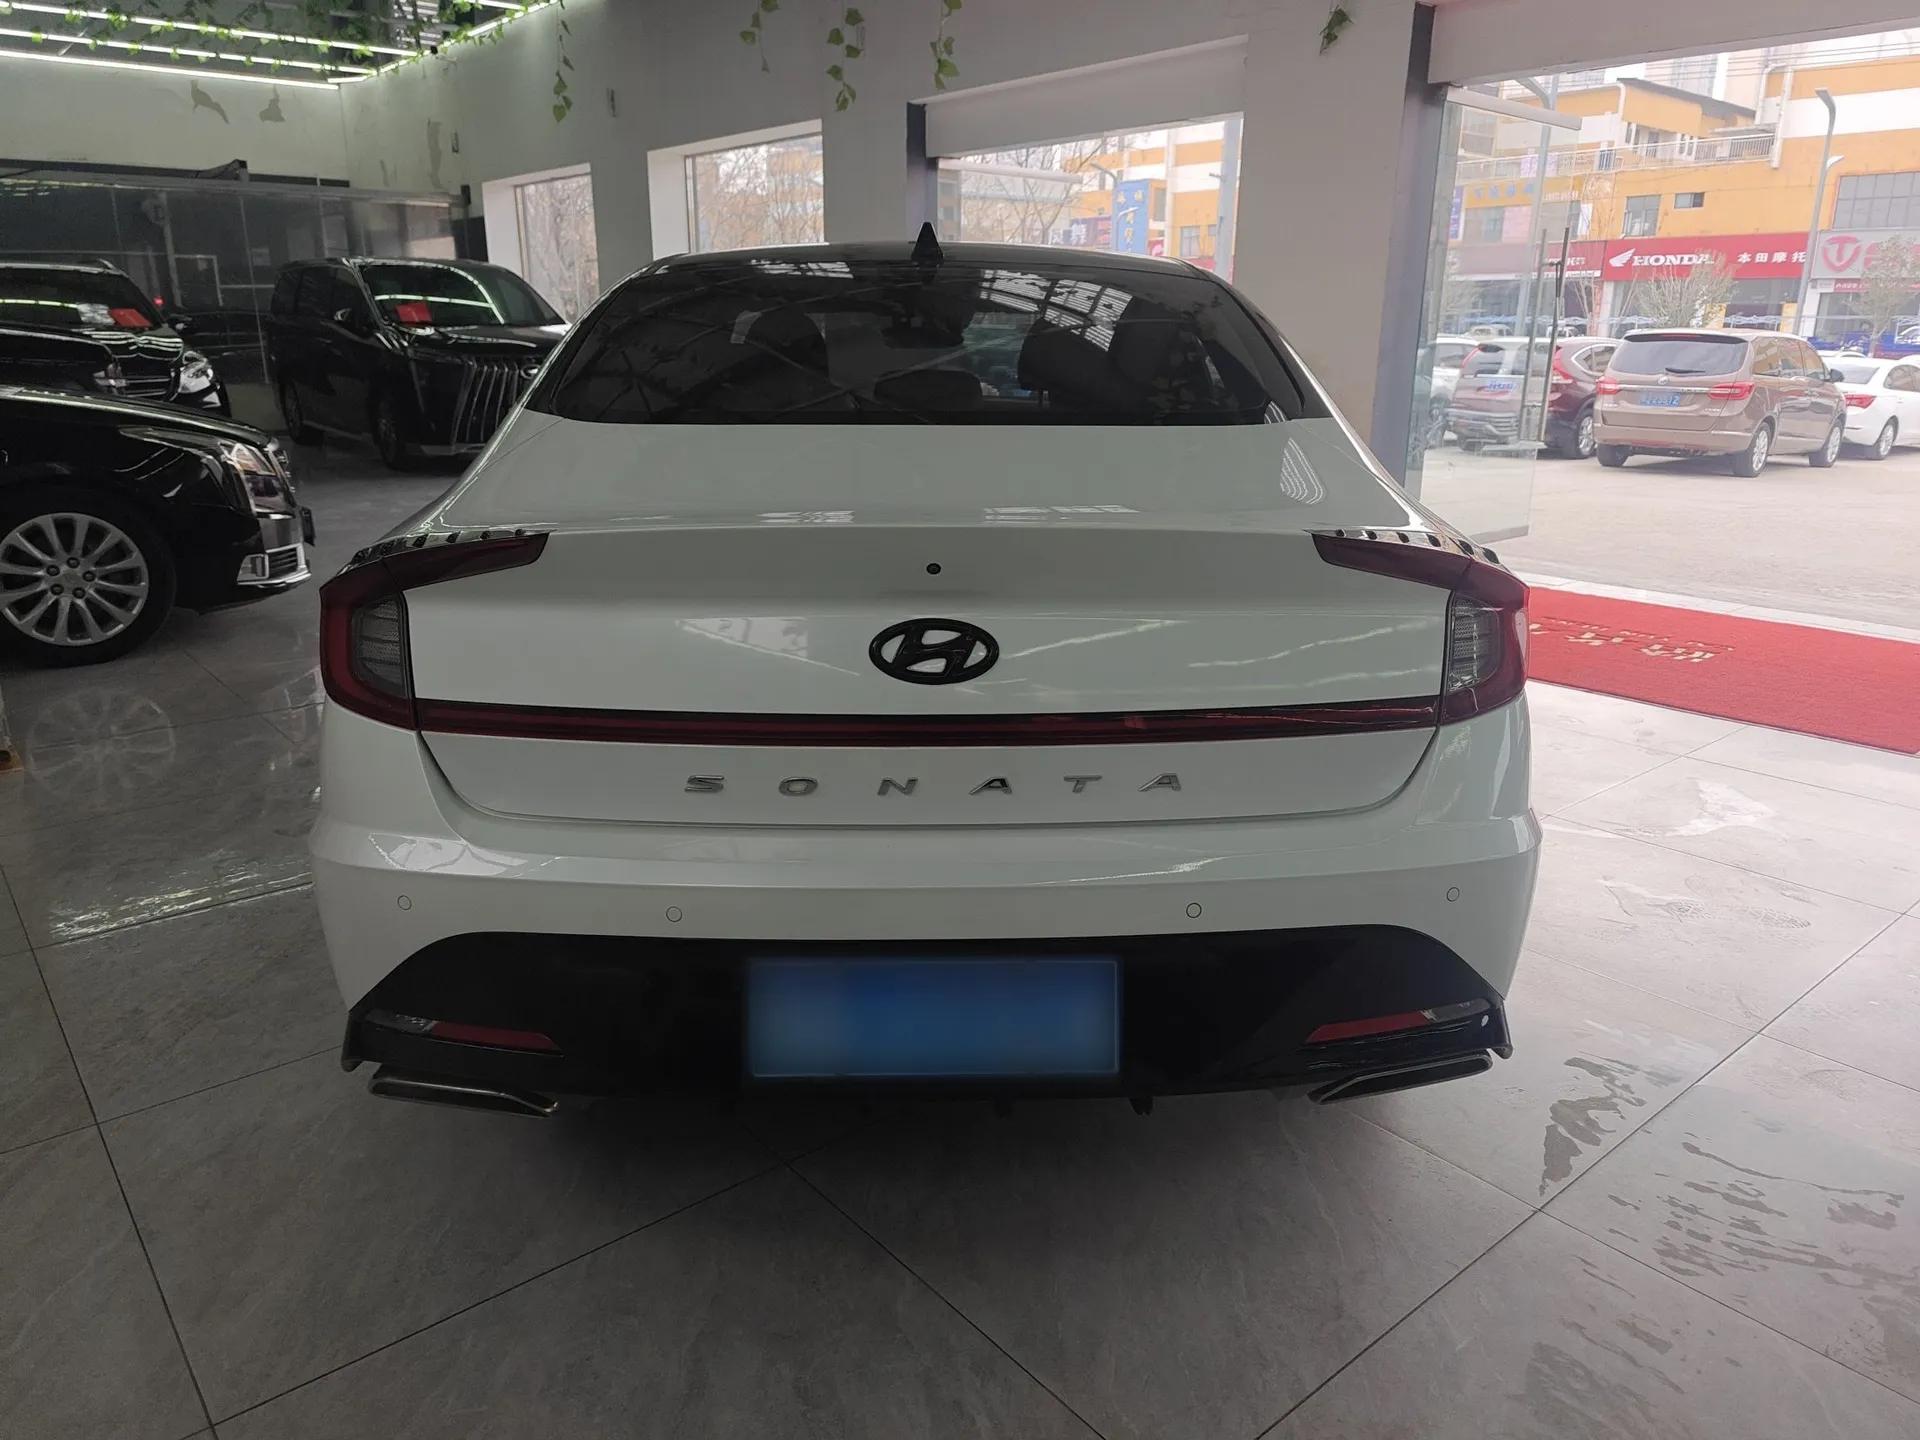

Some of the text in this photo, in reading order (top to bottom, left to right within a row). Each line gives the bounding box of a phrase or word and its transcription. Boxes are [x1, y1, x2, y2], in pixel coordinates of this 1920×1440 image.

[1632, 254, 1714, 267] HONDA
[1737, 250, 1806, 264] 本田摩托
[684, 772, 1182, 797] SONATA
